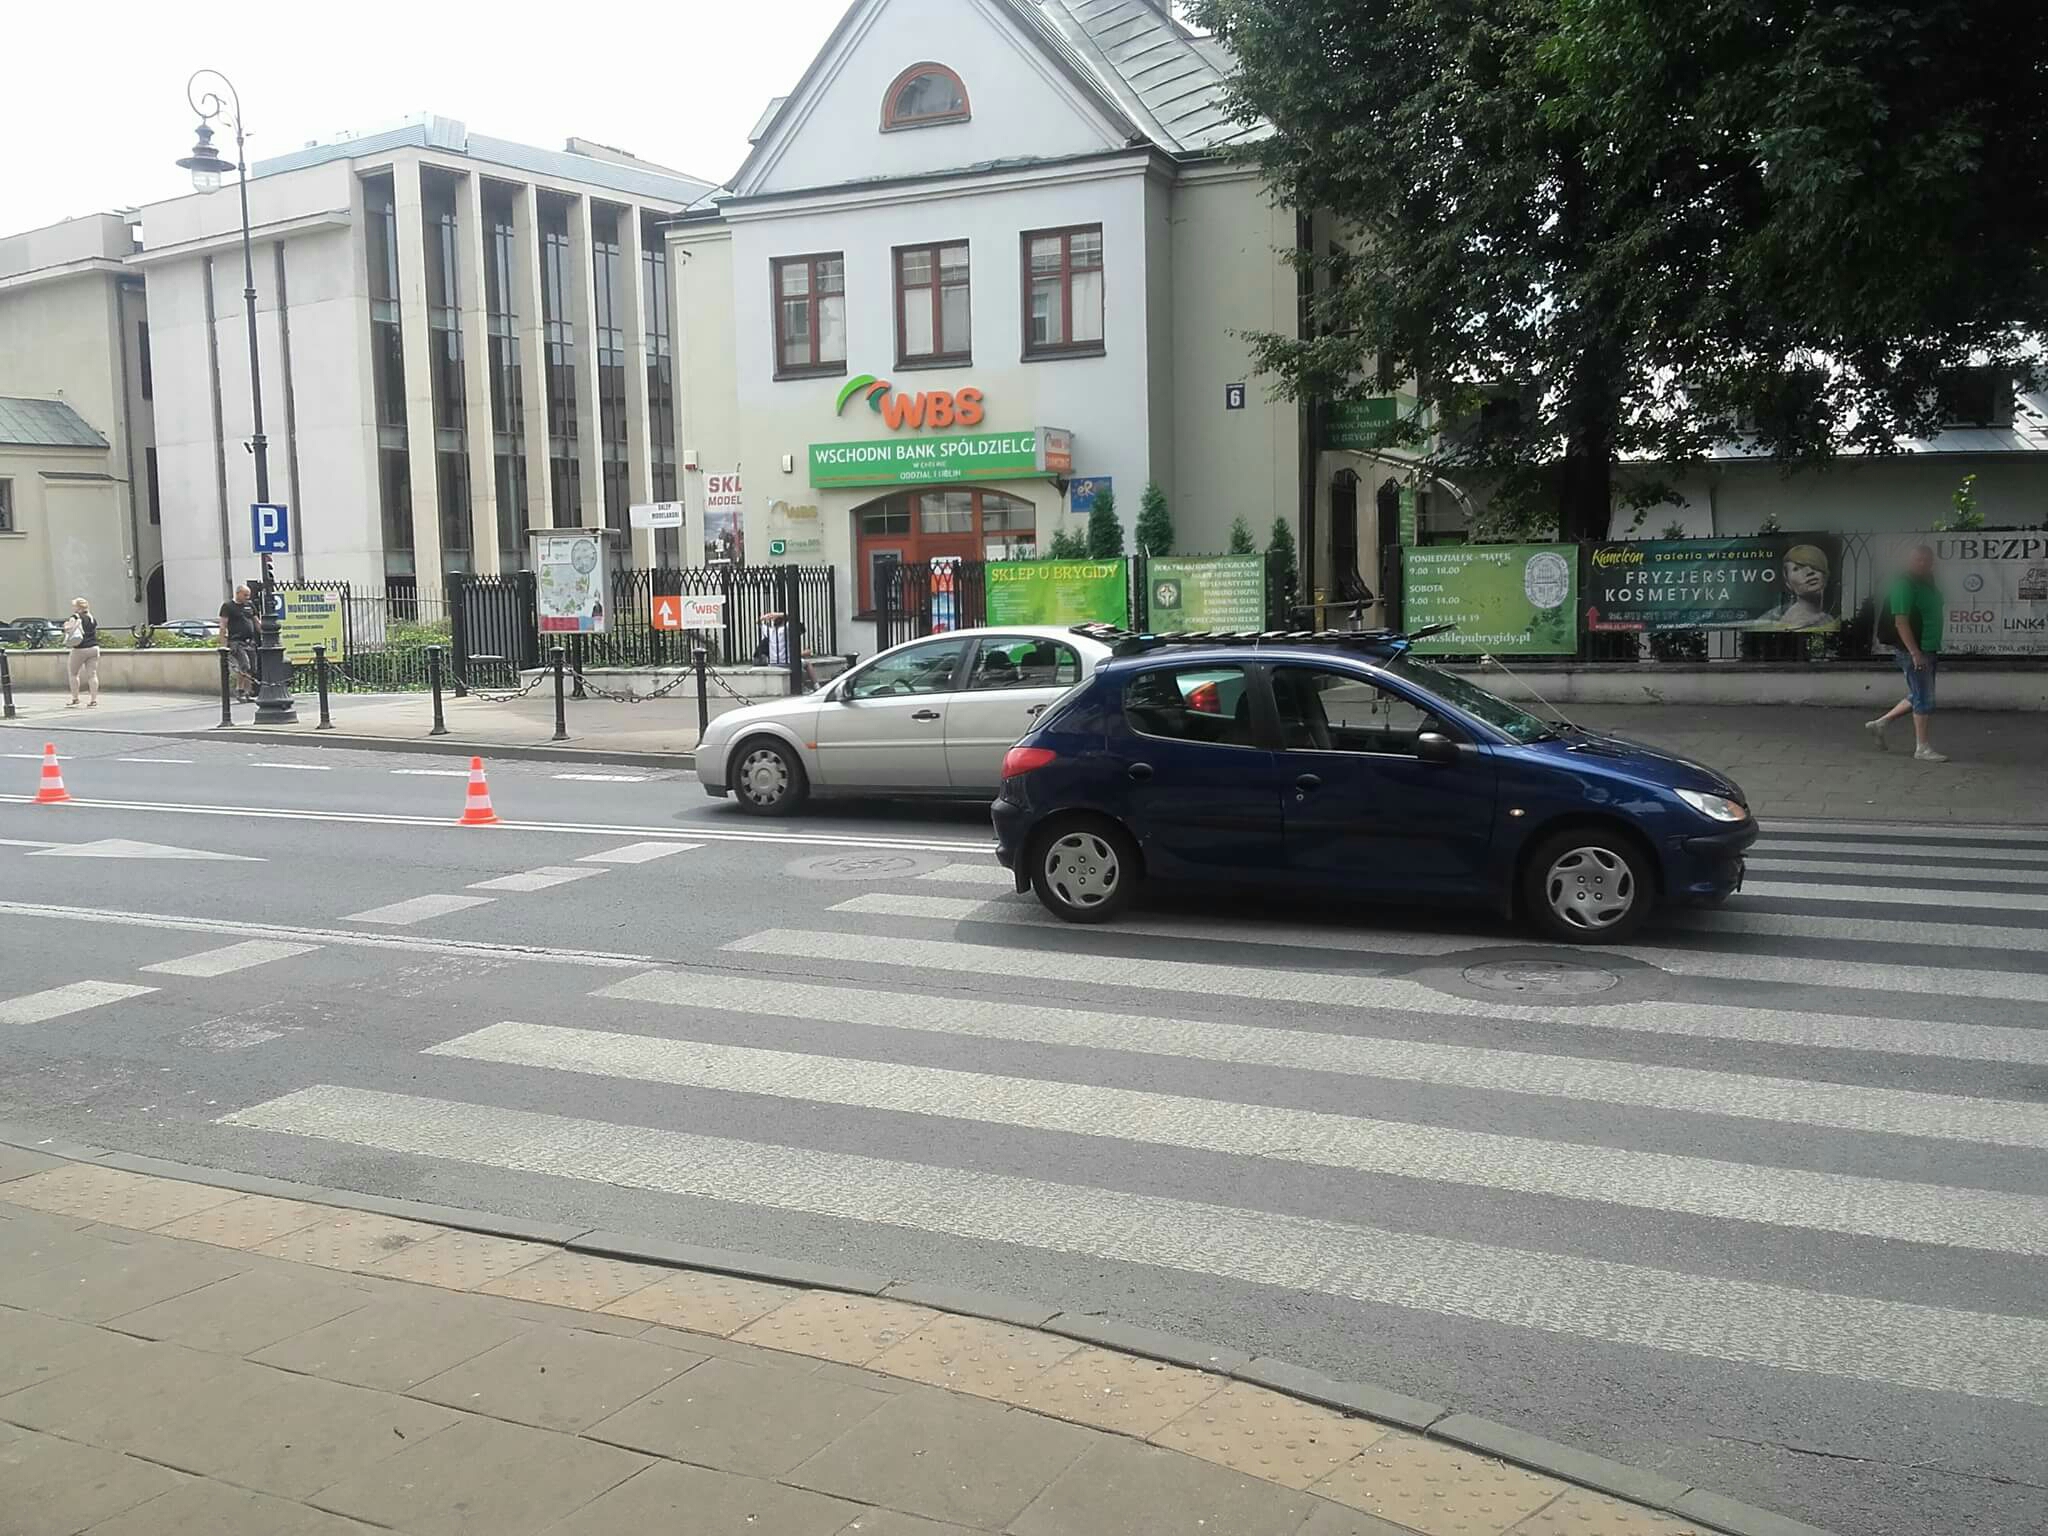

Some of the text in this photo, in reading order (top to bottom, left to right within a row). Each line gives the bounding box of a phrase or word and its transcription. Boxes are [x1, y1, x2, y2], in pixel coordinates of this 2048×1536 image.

[1230, 390, 1241, 407] 6
[881, 387, 984, 431] WBS
[815, 446, 892, 464] WSCHODNI
[896, 444, 936, 460] BANK
[708, 495, 742, 506] MODEL
[258, 507, 279, 546] P
[1592, 548, 1774, 568] Kameleon galeria wizerunku
[991, 564, 1118, 581] SKLEP U BRYGIDY
[1409, 567, 1429, 576] 9.00
[1436, 566, 1460, 575] 18.00
[1625, 568, 1776, 585] FRYZJERSTWO
[1409, 584, 1444, 593] SOBOTA
[1605, 588, 1730, 602] KOSMETYKA
[1409, 597, 1429, 606] 9.00
[695, 604, 720, 615] WBS
[1409, 615, 1423, 624] tel.
[1950, 610, 1994, 623] ERGO
[1950, 623, 1993, 633] HESTIA
[2003, 618, 2045, 630] LINK4
